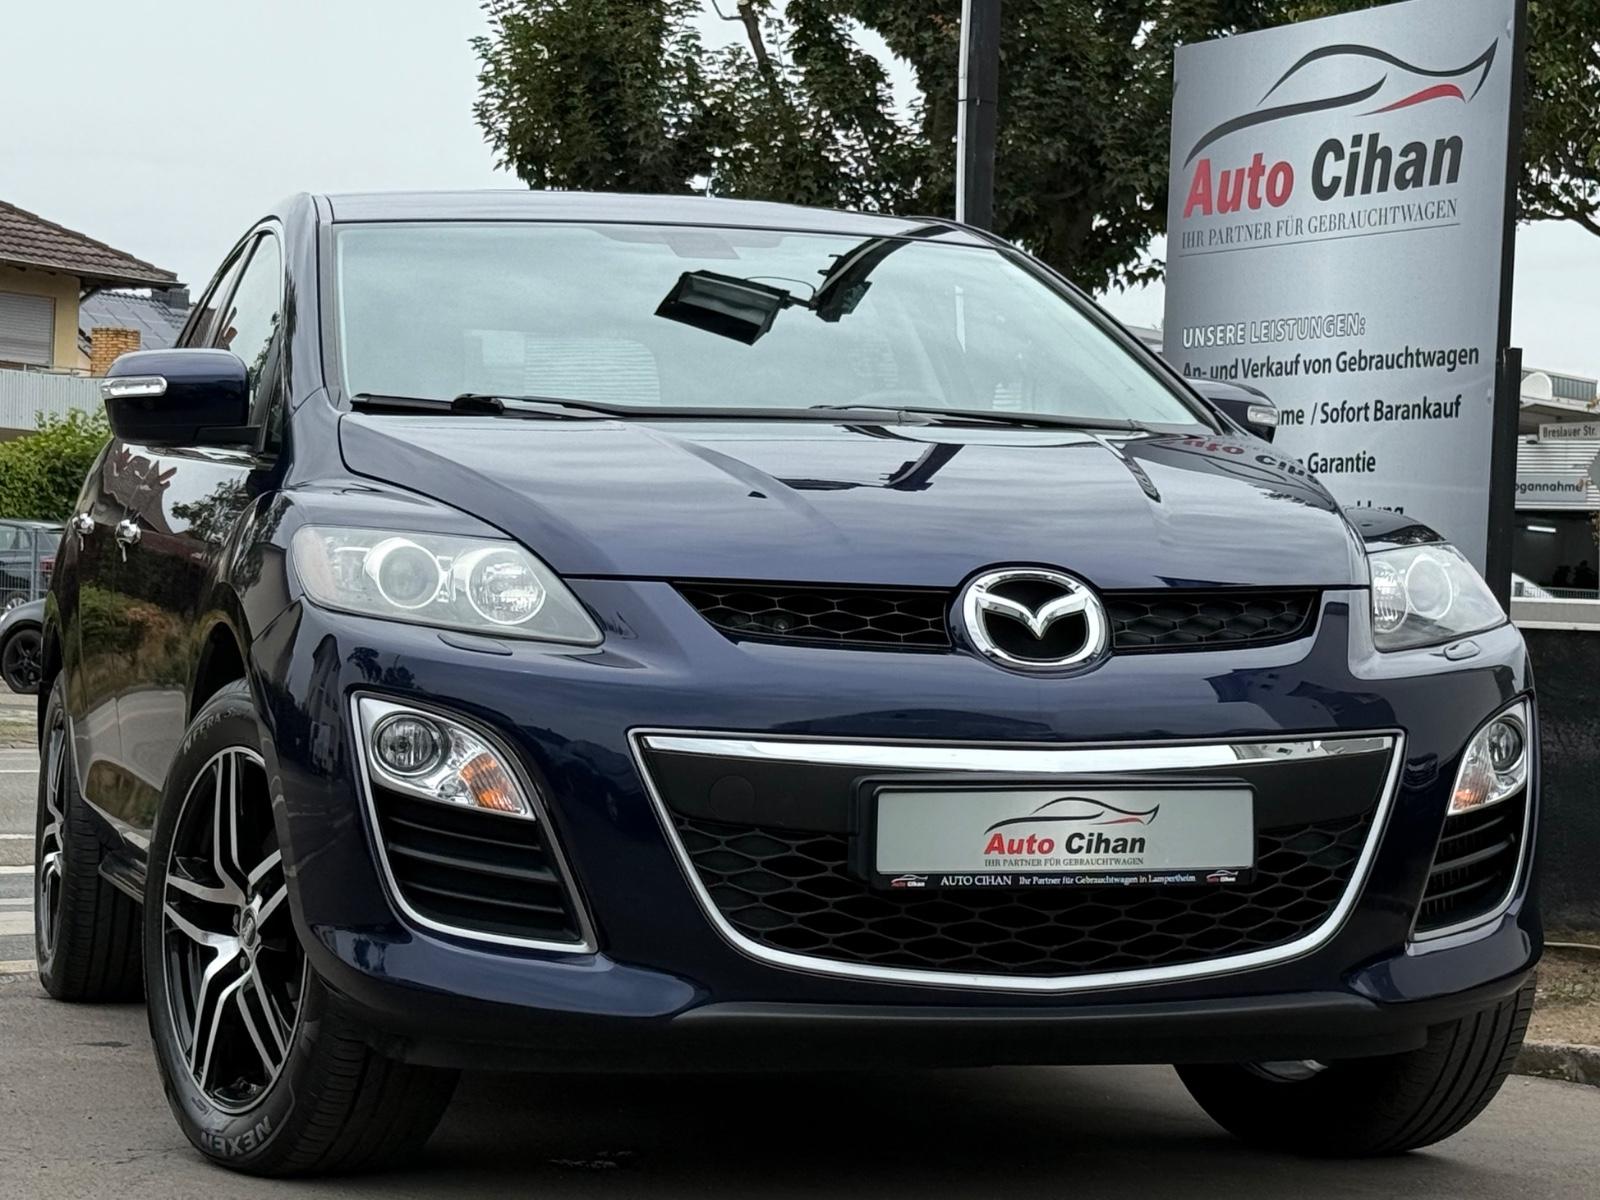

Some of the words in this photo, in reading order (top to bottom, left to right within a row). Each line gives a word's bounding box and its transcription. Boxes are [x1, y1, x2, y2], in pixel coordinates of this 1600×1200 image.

[1183, 153, 1294, 218] Auto
[1311, 132, 1463, 201] Cihan
[1182, 230, 1205, 249] IHR
[1208, 223, 1272, 246] PARTNER
[1276, 216, 1303, 237] FÜR
[1308, 198, 1458, 233] GEBRAUCHTWAGEN
[1182, 322, 1246, 349] UNSERE
[1250, 312, 1366, 343] LEISTUNGEN:
[1210, 358, 1238, 380] und
[1241, 353, 1301, 379] Verkauf
[1303, 357, 1332, 375] von
[1336, 345, 1479, 373] Gebrauchtwagen
[1320, 400, 1370, 424] Sofort
[1373, 394, 1462, 422] Barankauf
[1542, 426, 1581, 438] Breslauer
[1307, 450, 1376, 474] Garantie
[984, 833, 1055, 855] Auto
[1065, 832, 1146, 854] Cihan
[984, 859, 1001, 867] IHR
[1003, 858, 1042, 867] PARTNER
[1044, 857, 1061, 866] FÜR
[1063, 857, 1144, 866] GEBRAUCHTWAGEN
[940, 875, 973, 886] AUTO
[975, 875, 1012, 886] CIHAN
[1032, 876, 1061, 885] Partner
[201, 1115, 272, 1157] NEXEN
